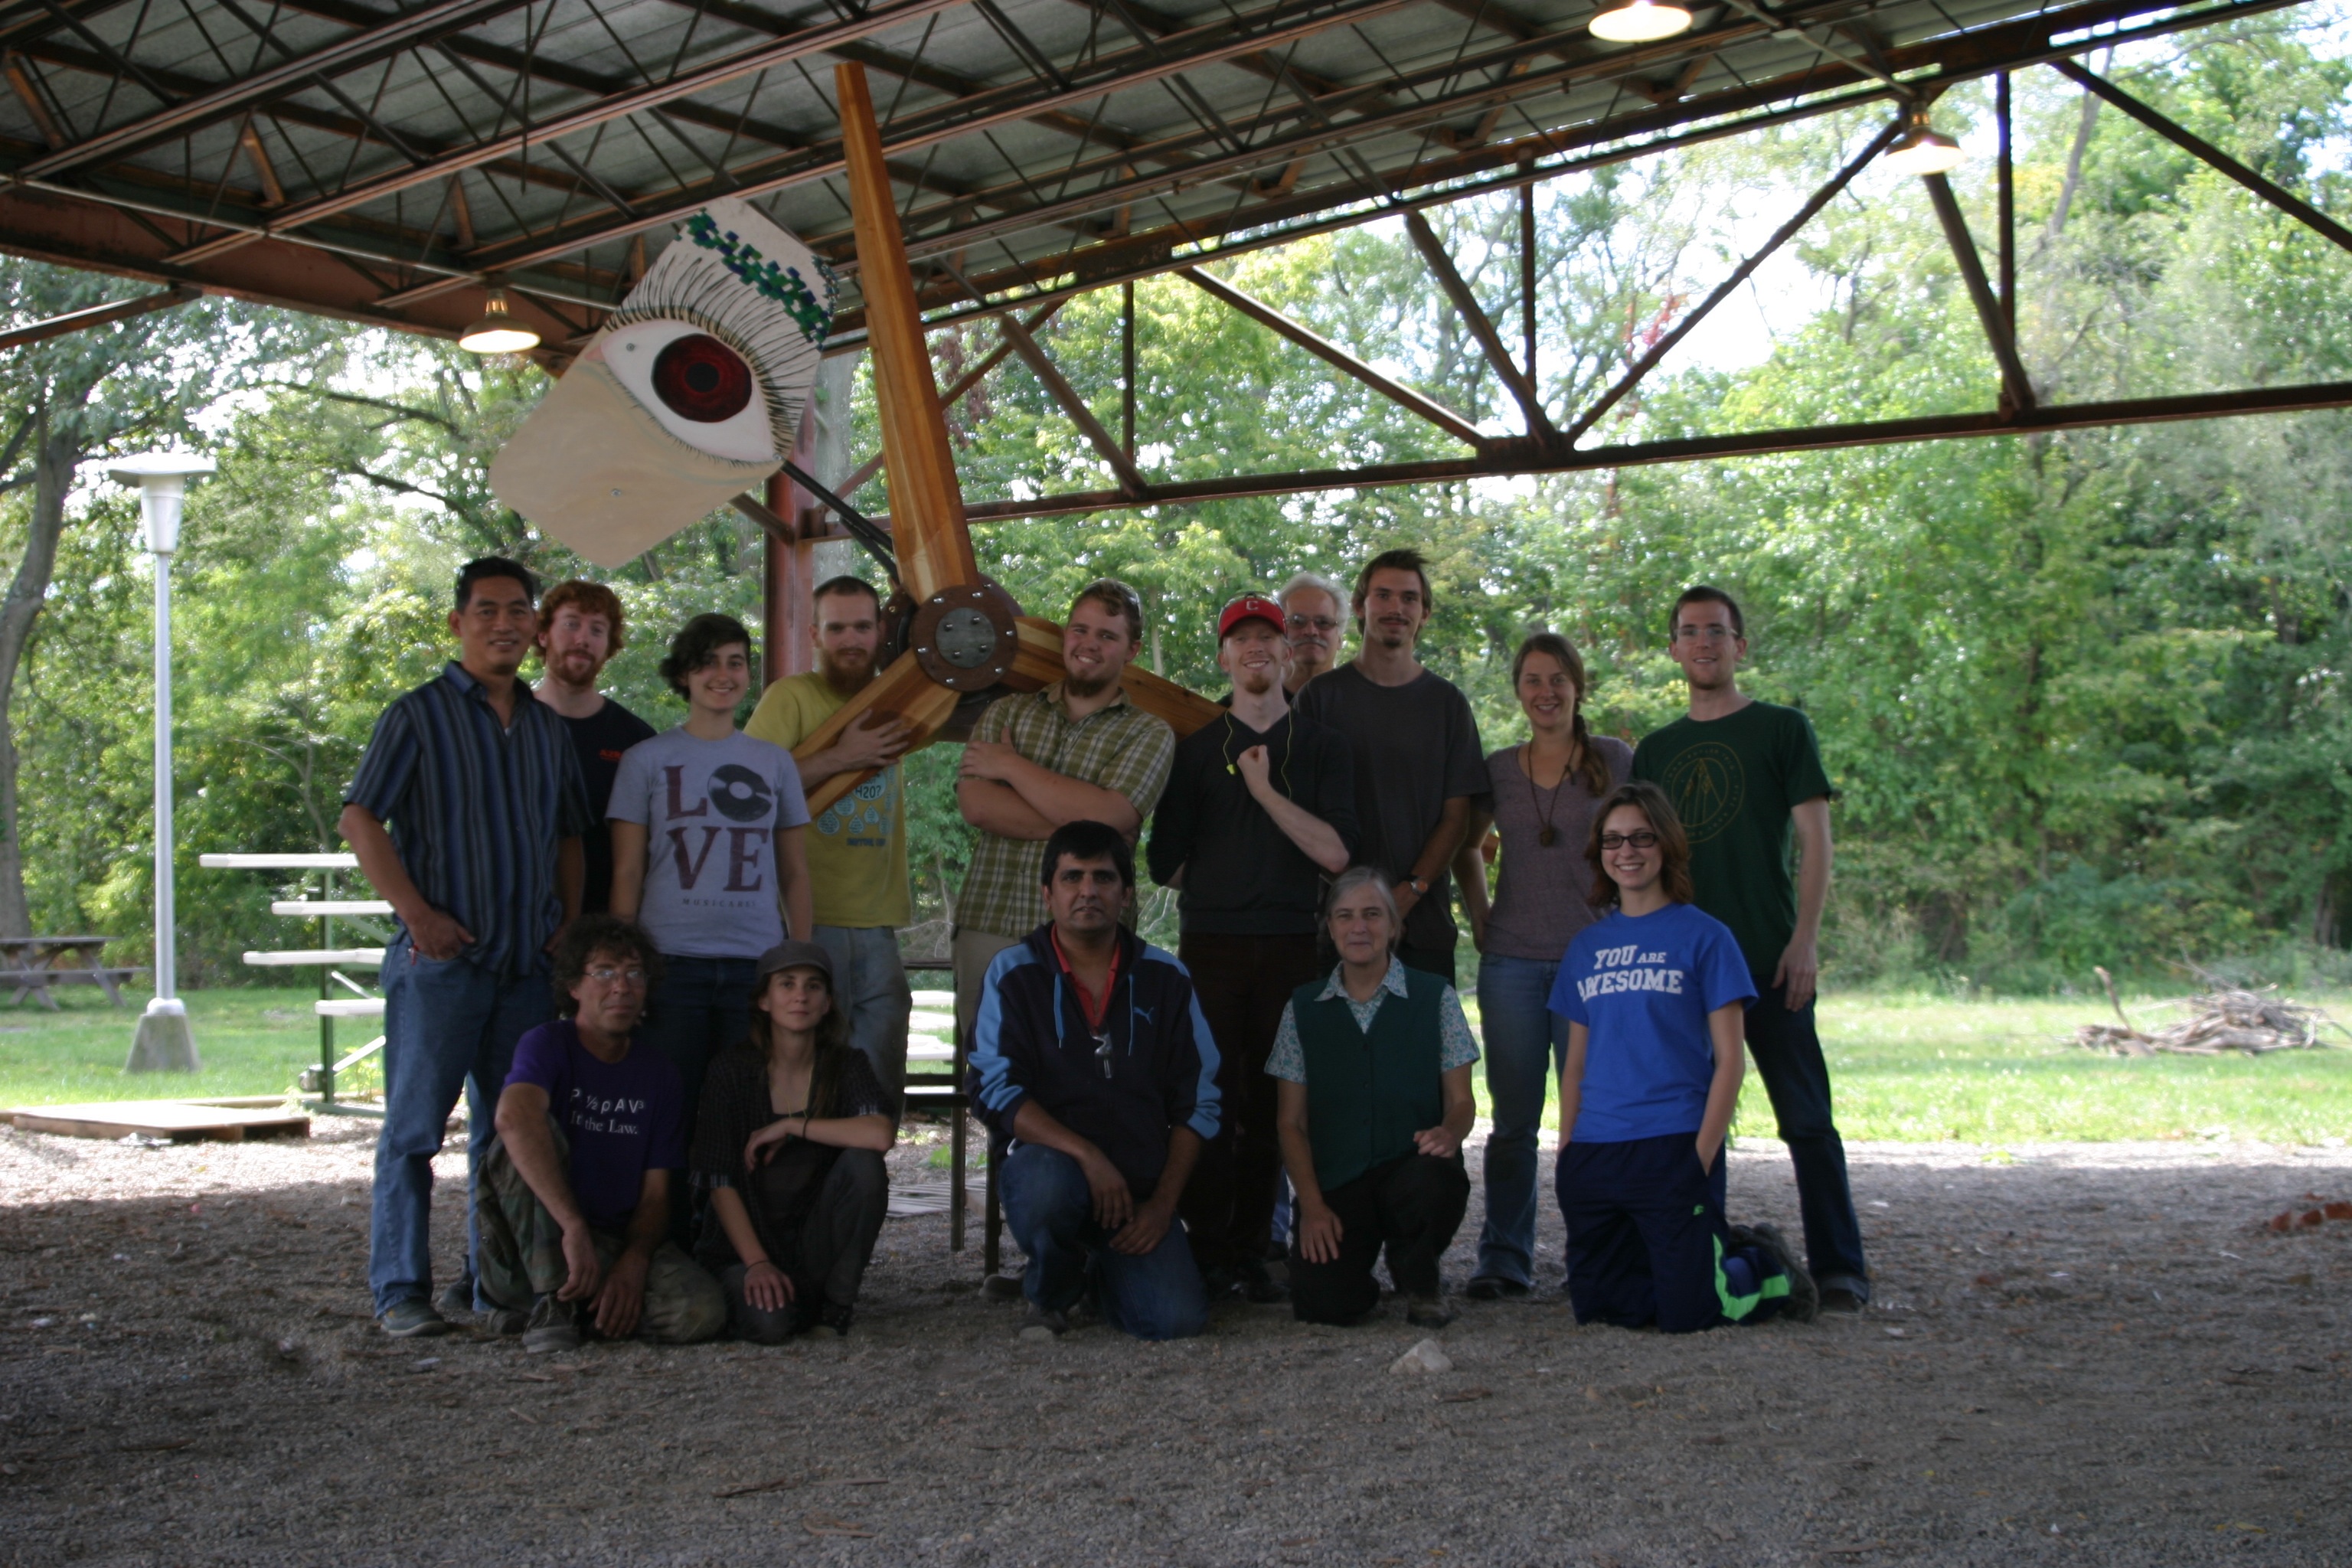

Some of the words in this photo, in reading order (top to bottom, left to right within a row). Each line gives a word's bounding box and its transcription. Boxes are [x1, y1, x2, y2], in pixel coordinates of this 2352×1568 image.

[1246, 600, 1259, 610] C
[1593, 945, 1638, 970] YOU
[1636, 952, 1667, 964] ARE
[1576, 968, 1684, 1003] AWESOME
[585, 1116, 604, 1132] the
[608, 1118, 638, 1135] Law.
